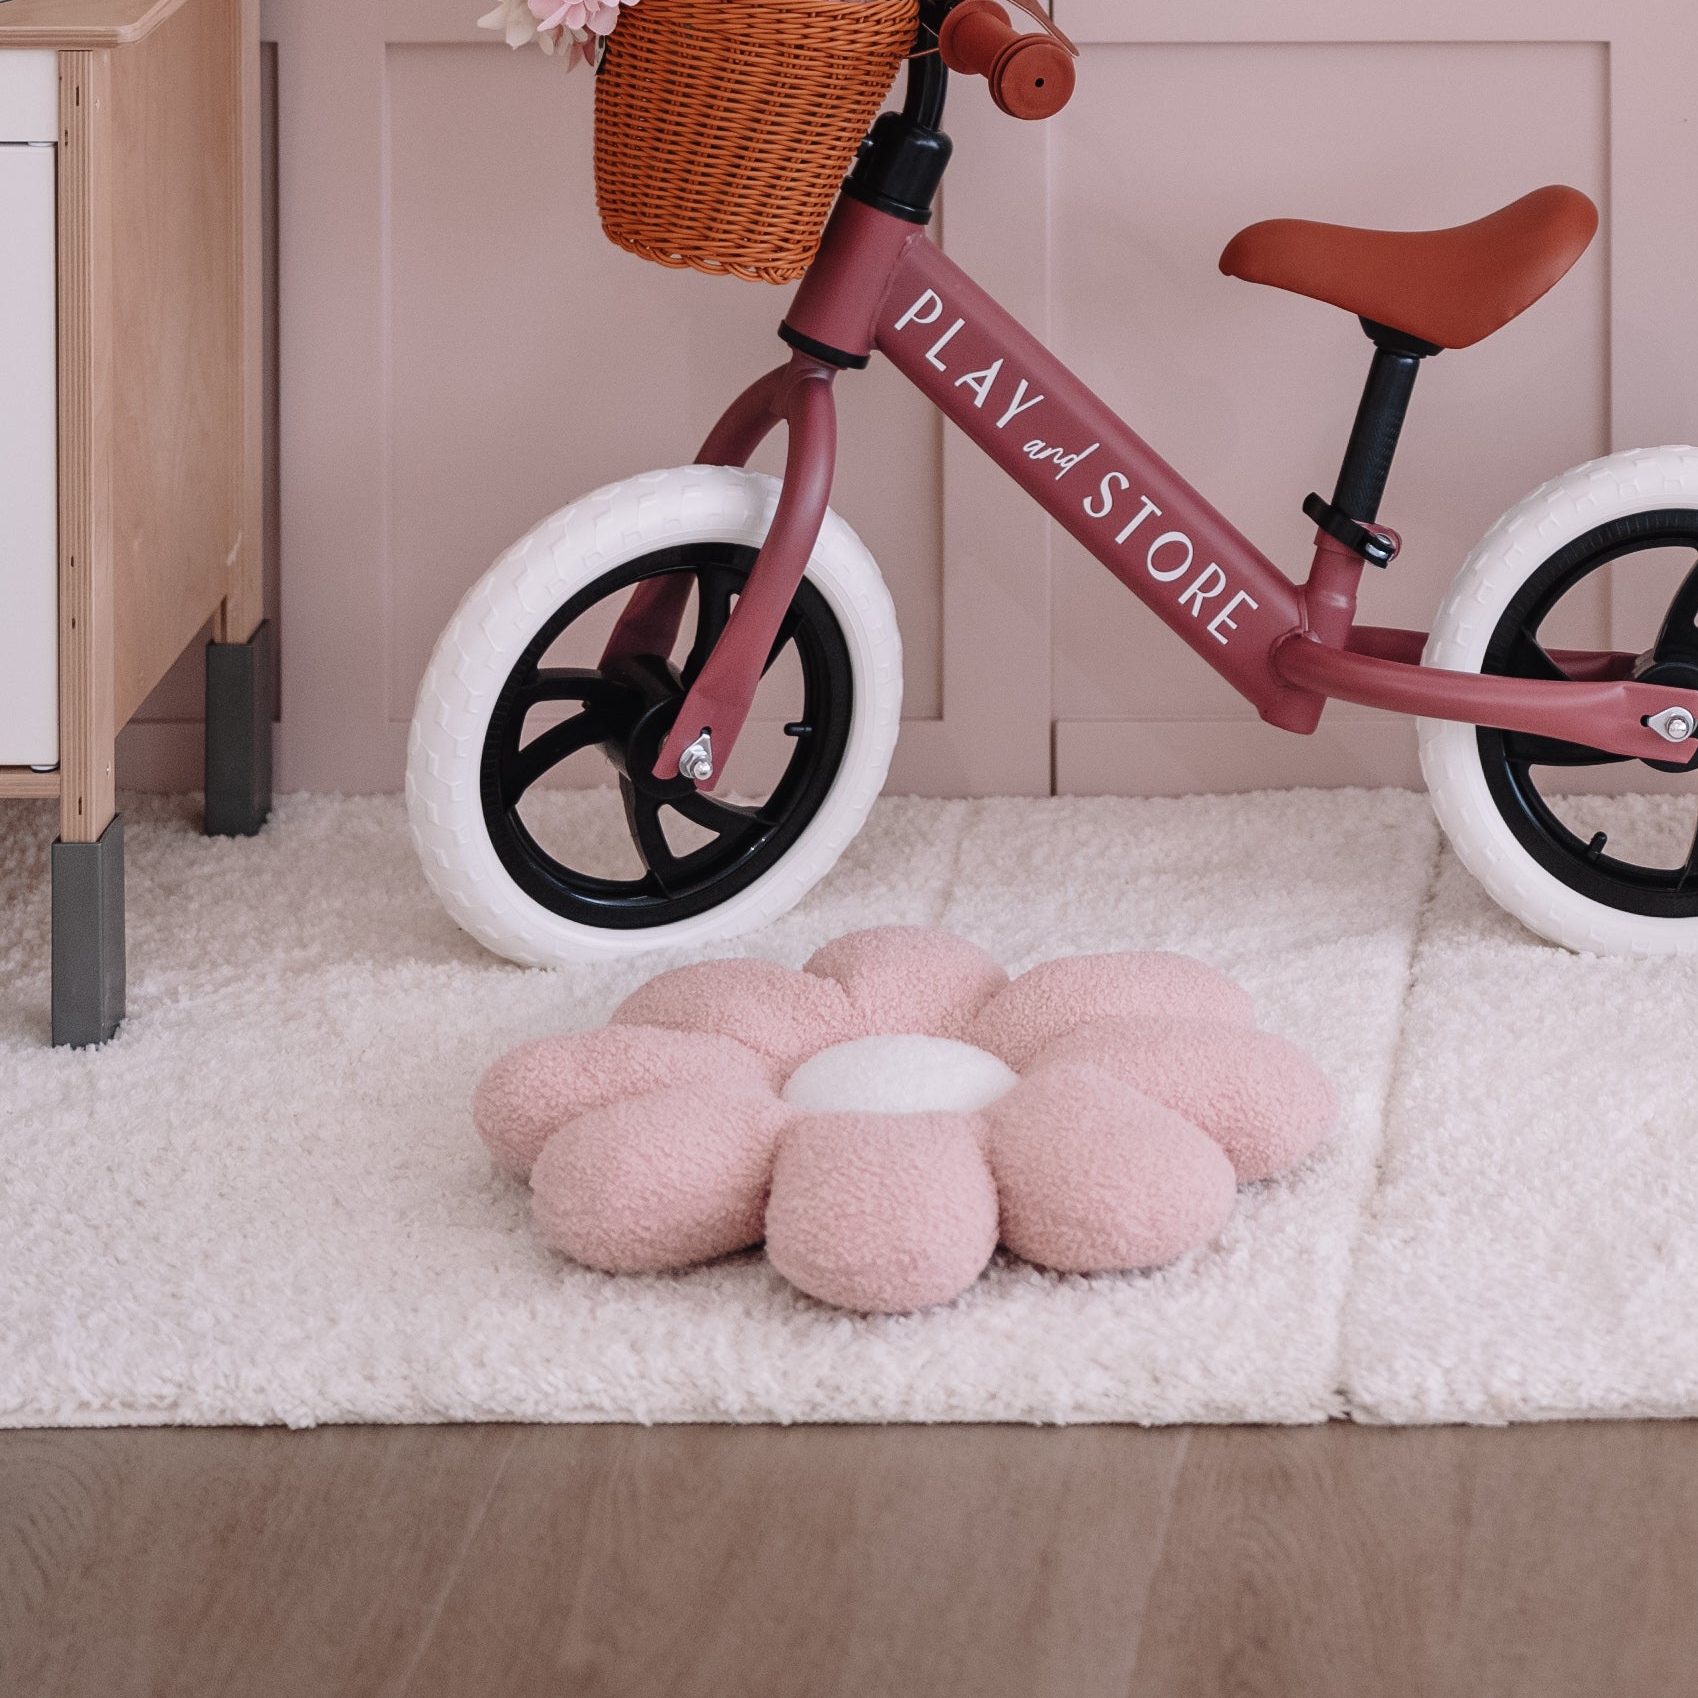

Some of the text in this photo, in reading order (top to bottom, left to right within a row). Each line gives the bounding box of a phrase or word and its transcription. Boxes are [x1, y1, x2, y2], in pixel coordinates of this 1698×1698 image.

[893, 288, 1260, 646] PLAY and STORE
